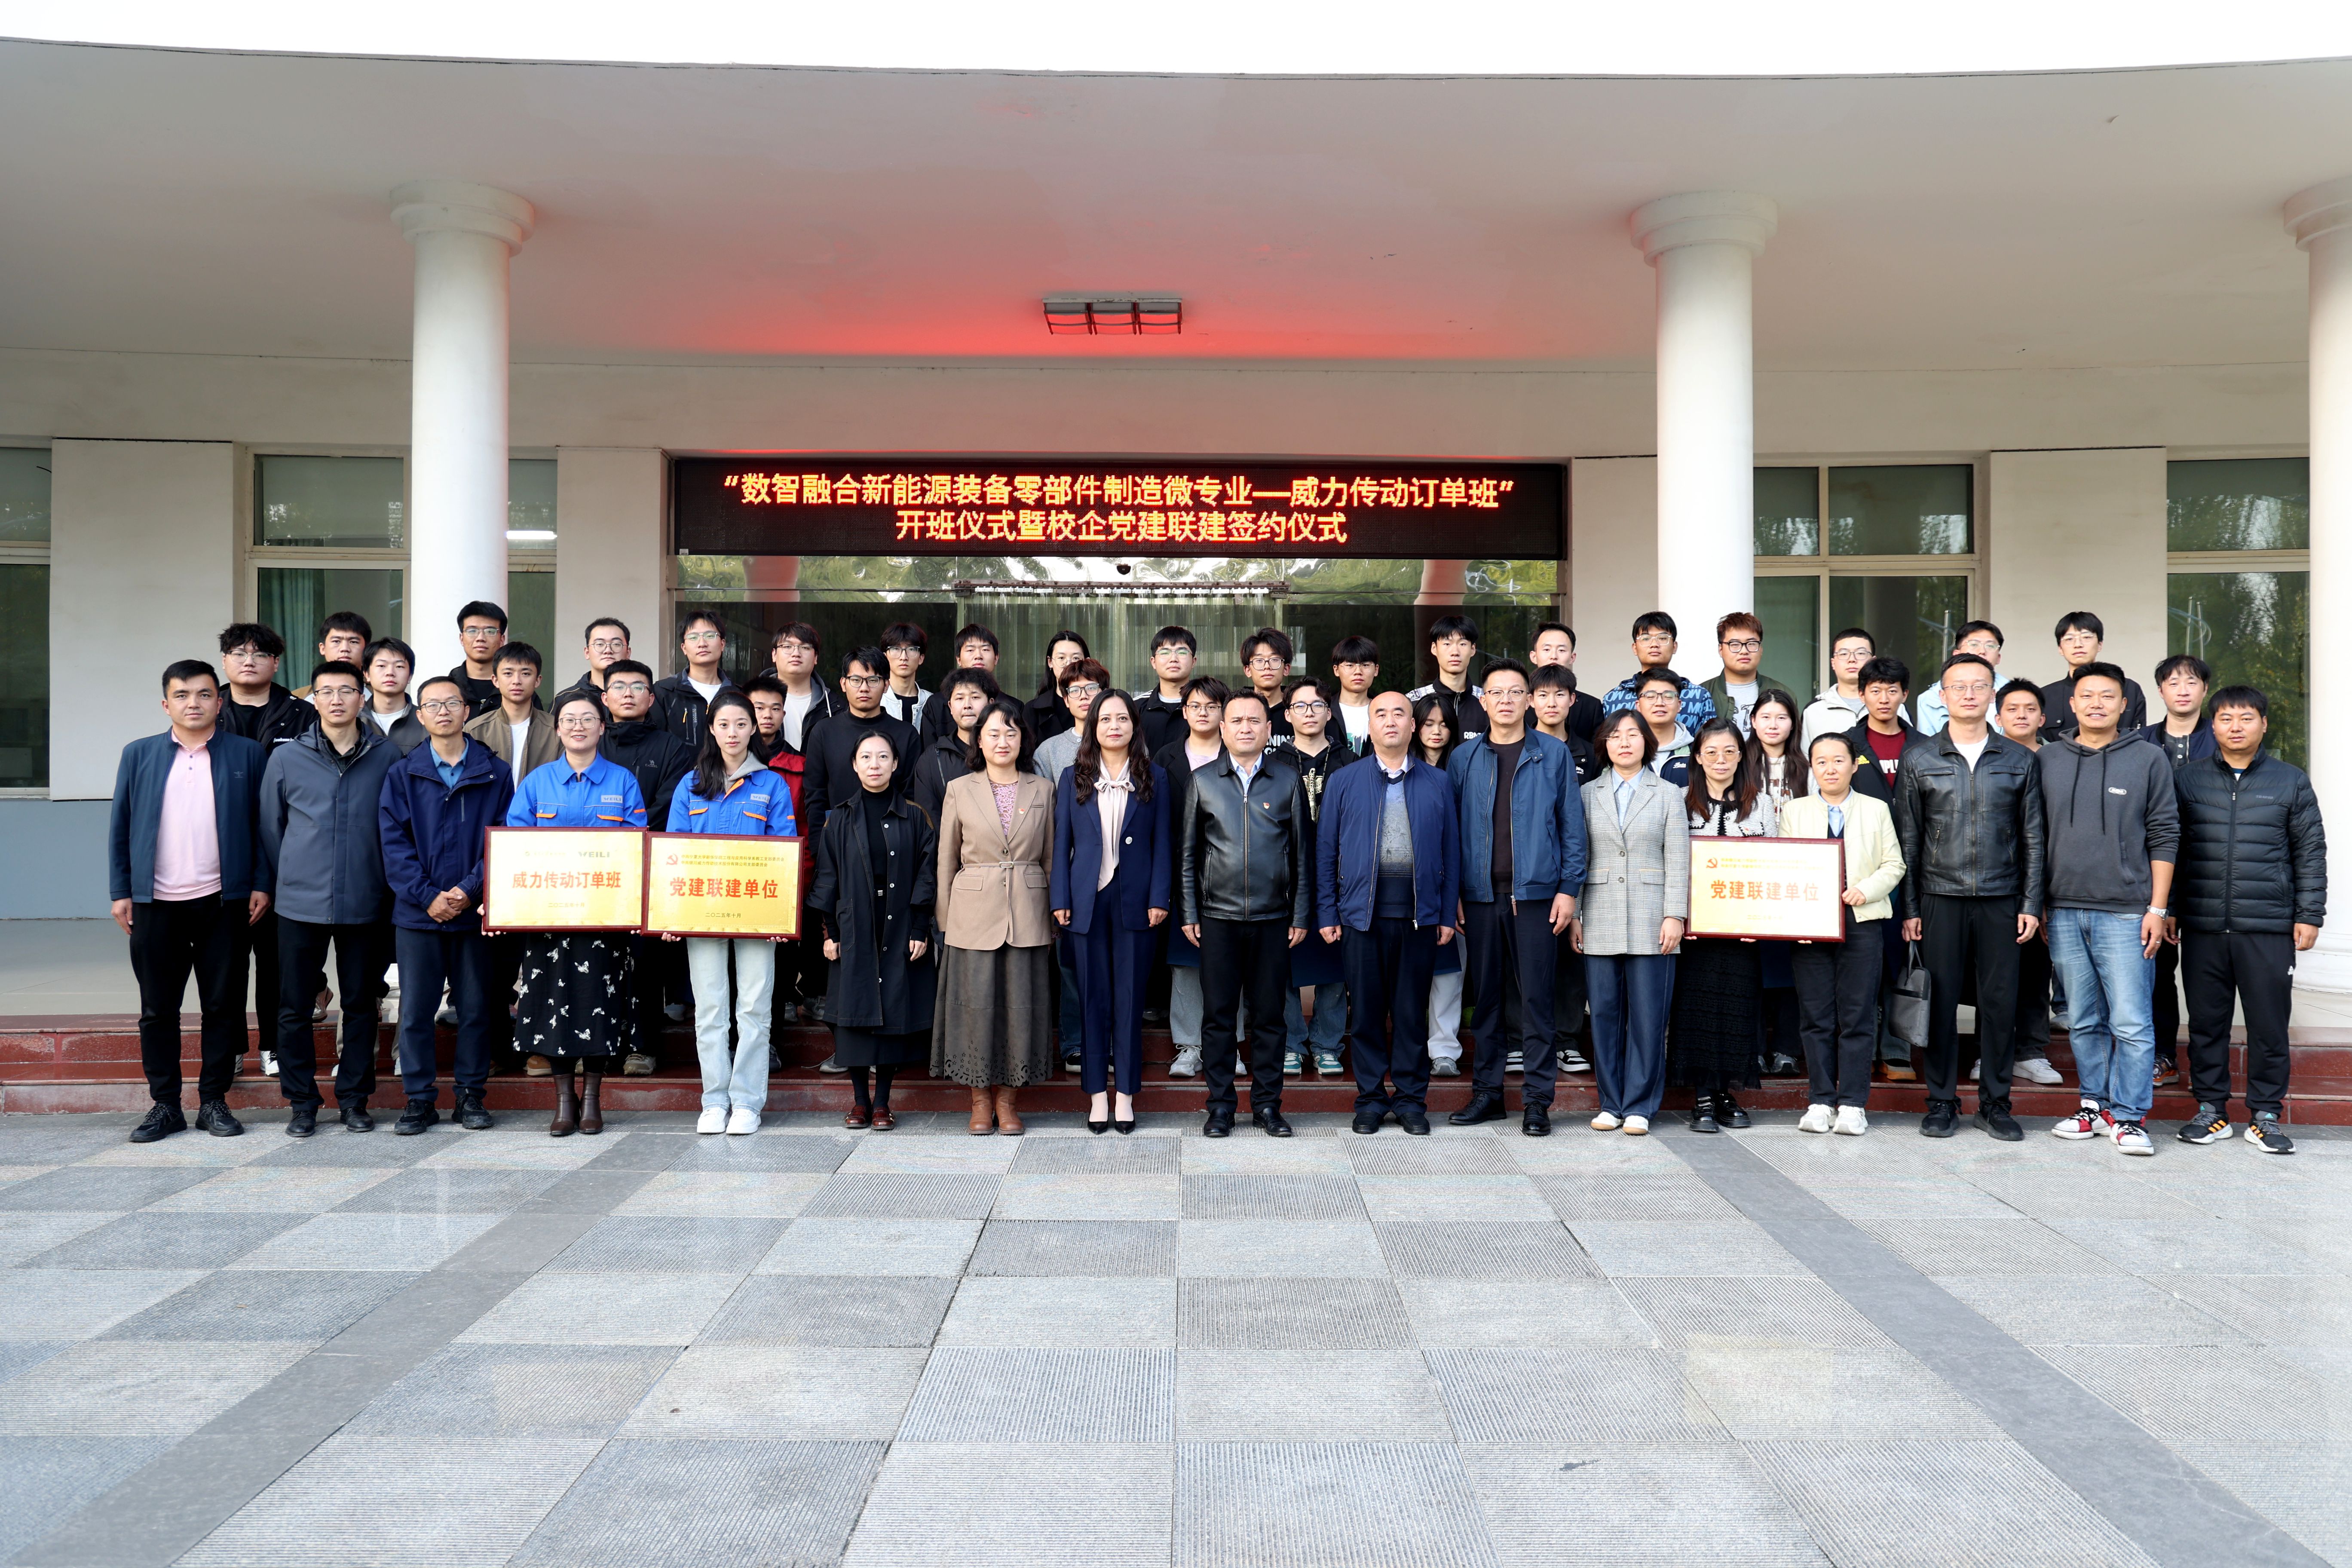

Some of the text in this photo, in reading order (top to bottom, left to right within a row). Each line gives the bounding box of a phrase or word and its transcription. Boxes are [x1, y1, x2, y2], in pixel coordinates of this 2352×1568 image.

[896, 509, 1348, 542] 开班仪式暨校企党建联建签约仪式
[512, 871, 621, 889] 威力传动订单班
[670, 877, 778, 899] 党建联建单位
[1711, 880, 1819, 901] 党建联建单位
